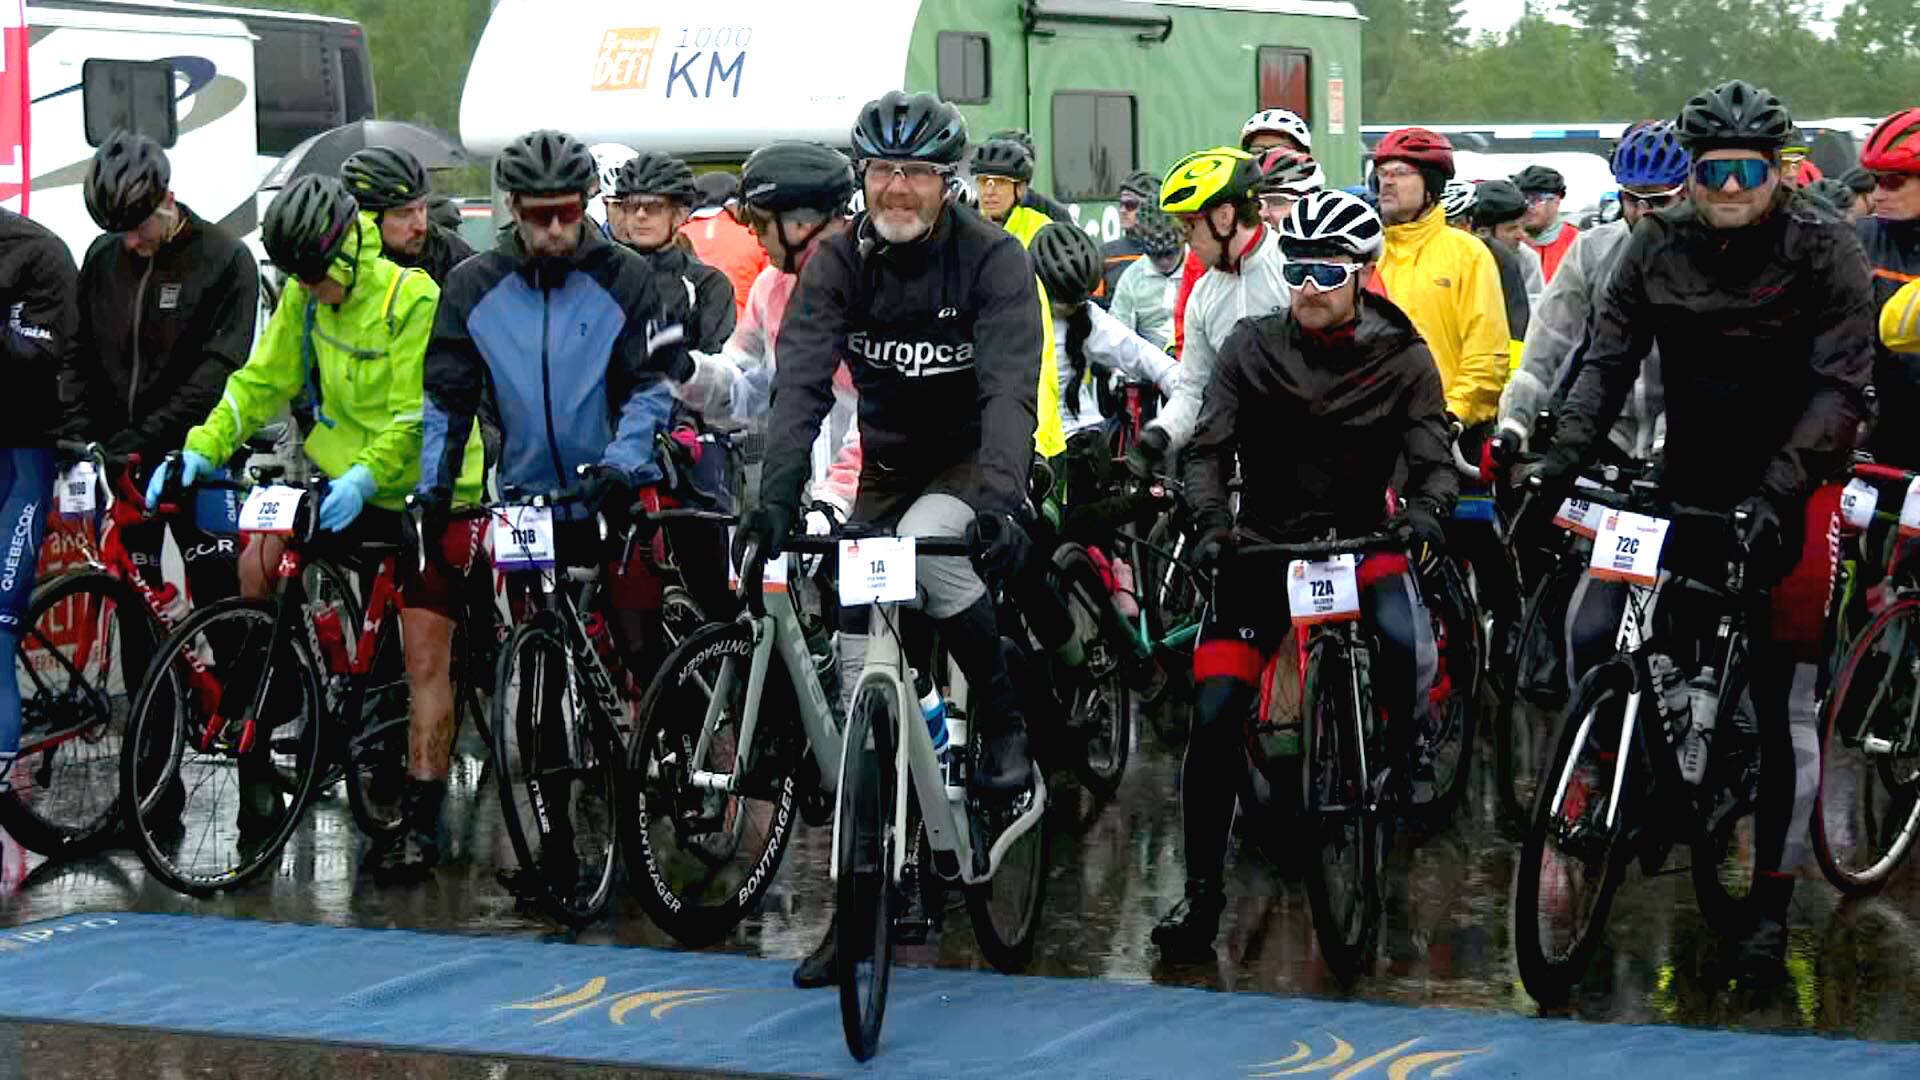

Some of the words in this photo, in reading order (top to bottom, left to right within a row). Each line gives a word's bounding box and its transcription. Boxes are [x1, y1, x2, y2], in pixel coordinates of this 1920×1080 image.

[675, 26, 752, 49] 1000
[666, 50, 746, 98] KM
[848, 331, 975, 377] Europca
[259, 501, 280, 515] 73C
[1, 502, 37, 592] QUÉBECOR
[869, 560, 886, 574] 1A
[1616, 536, 1640, 555] 72C
[1309, 579, 1335, 597] 72A
[678, 639, 749, 687] ONTRAGER
[638, 792, 682, 914] BONTRAGER
[739, 776, 795, 908] BONTRAGER
